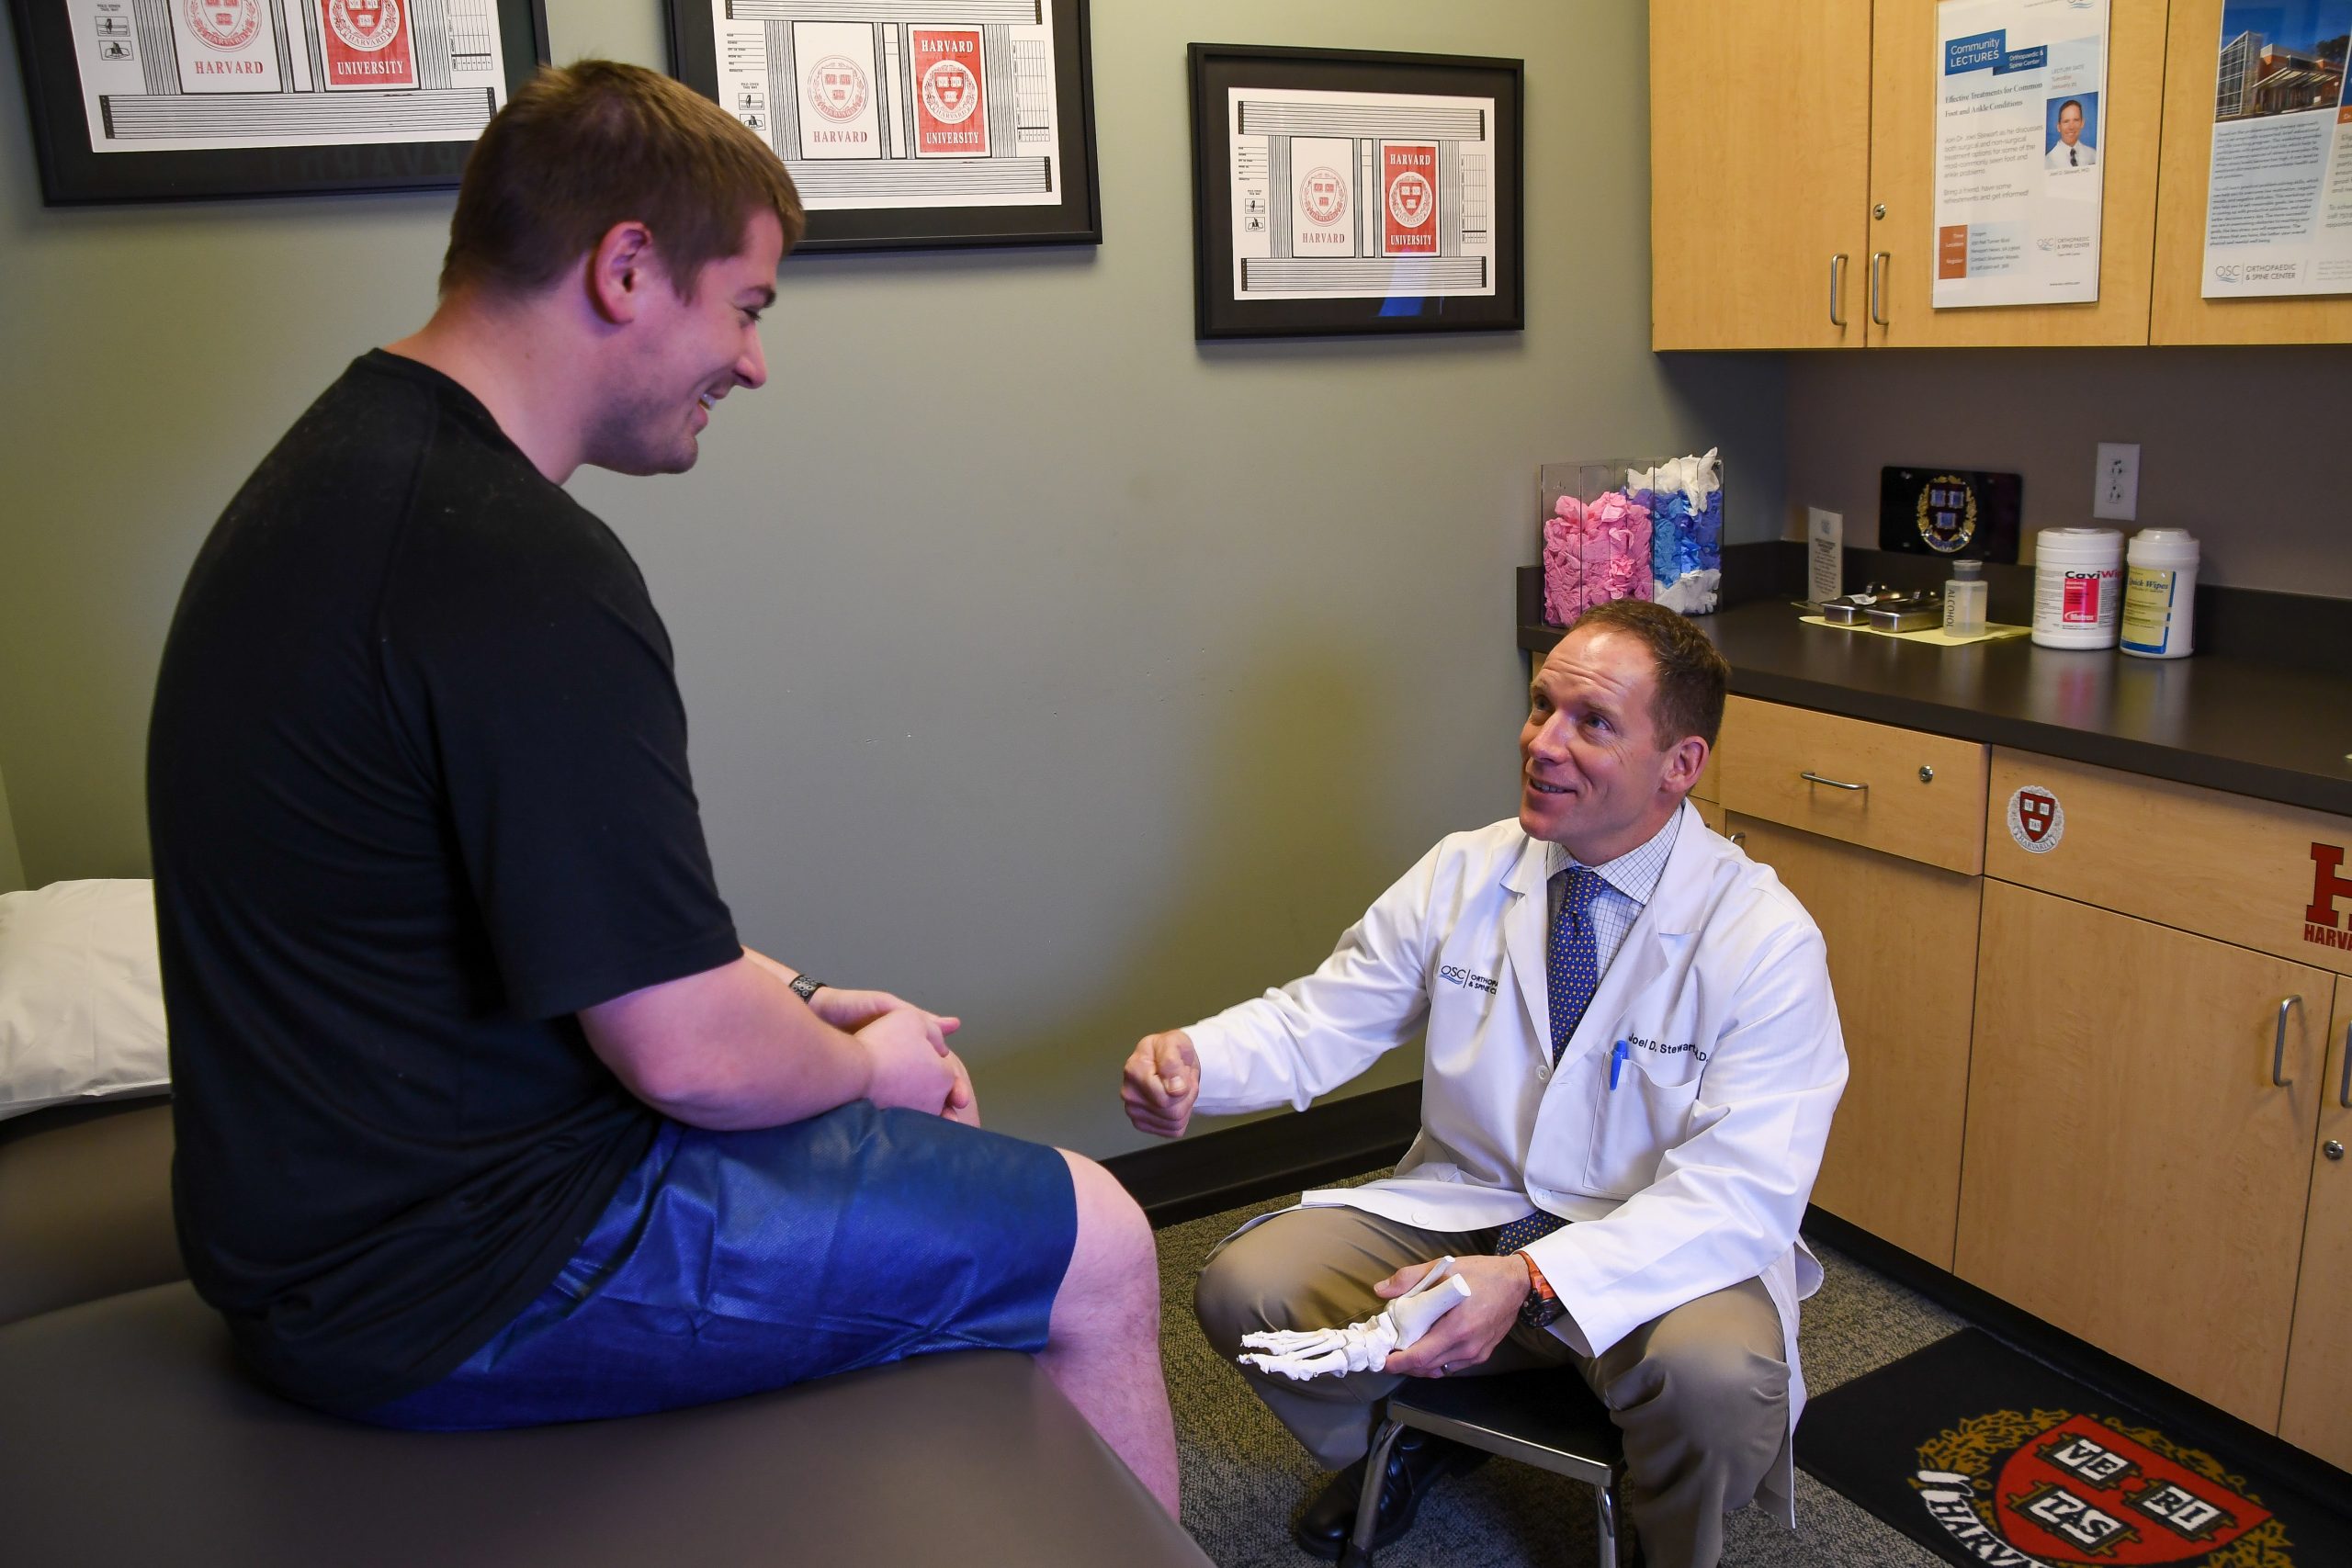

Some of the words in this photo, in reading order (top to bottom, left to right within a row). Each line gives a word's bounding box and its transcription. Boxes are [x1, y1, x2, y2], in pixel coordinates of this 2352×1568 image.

[348, 34, 387, 47] HARVARD
[922, 39, 973, 53] HARVARD
[1951, 38, 1999, 55] Community
[1951, 50, 1999, 67] LECTURES
[2009, 51, 2039, 62] Orthopaedic
[195, 61, 264, 74] HARVARD
[337, 61, 404, 75] UNIVERSITY
[2009, 61, 2022, 69] Spine
[1946, 93, 1969, 104] Effective
[1972, 88, 2003, 99] Treatments
[2004, 86, 2012, 95] for
[2014, 82, 2043, 93] Common
[1945, 108, 1958, 117] Foot
[1960, 107, 1970, 115] and
[1973, 104, 1988, 113] Ankle
[1990, 99, 2023, 110] Conditions
[814, 130, 867, 143] HARVARD
[926, 131, 978, 144] UNIVERSITY
[1977, 130, 1998, 139] Stewart
[1390, 153, 1430, 165] HARVARD
[1302, 232, 1345, 243] HARVARD
[1390, 235, 1432, 245] UNIVERSITY
[2036, 238, 2054, 248] OSC
[2215, 265, 2241, 277] OSC
[2245, 264, 2296, 273] ORTHOPAEDIC
[2145, 580, 2169, 590] Wipes
[1946, 588, 1956, 627] ALCOHOL
[2018, 835, 2050, 851] HARVARD
[1441, 964, 1466, 980] OSC
[1470, 974, 1498, 987] ORTHOPA
[1474, 982, 1489, 993] SPINE
[1628, 1032, 1648, 1048] Joel
[1648, 1040, 1657, 1053] D.
[2064, 1441, 2120, 1479] VE
[2152, 1486, 2208, 1525] RI
[2042, 1495, 2114, 1540] TAS
